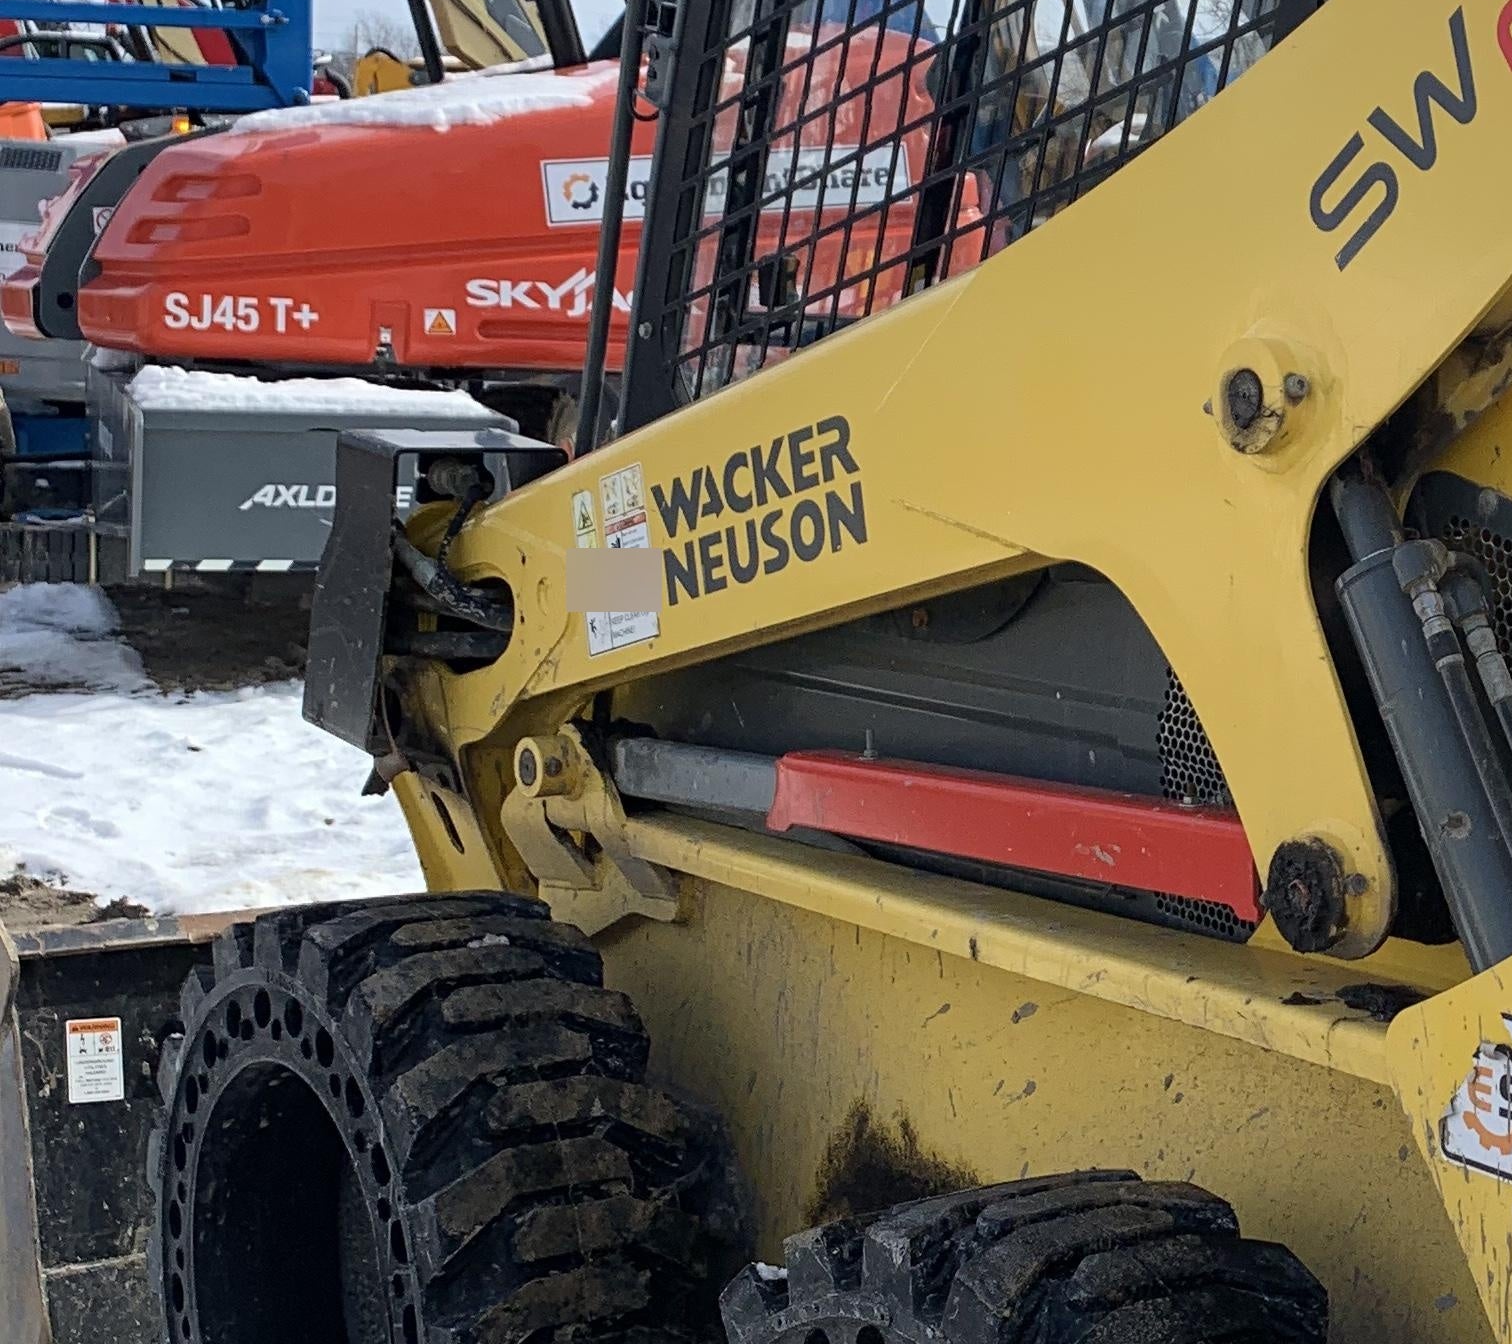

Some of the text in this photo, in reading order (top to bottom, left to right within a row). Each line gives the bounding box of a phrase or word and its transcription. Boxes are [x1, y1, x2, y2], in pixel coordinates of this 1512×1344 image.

[164, 292, 320, 334] SJ45 T+
[650, 414, 860, 541] WACKER
[661, 480, 868, 606] NEUSON
